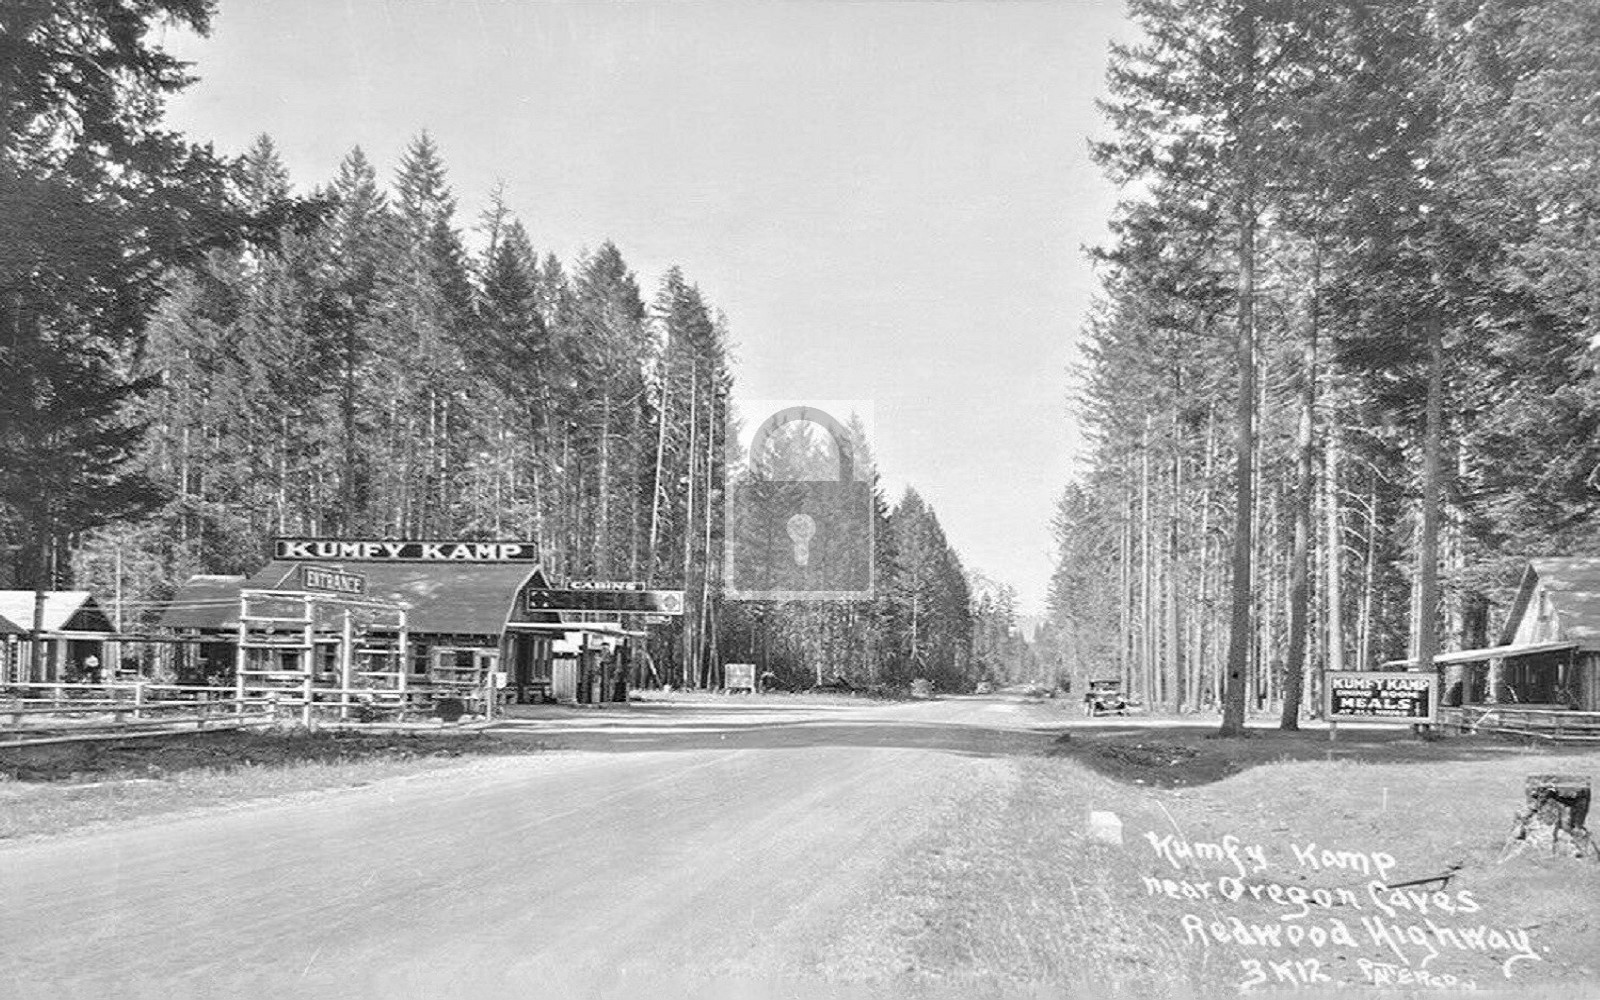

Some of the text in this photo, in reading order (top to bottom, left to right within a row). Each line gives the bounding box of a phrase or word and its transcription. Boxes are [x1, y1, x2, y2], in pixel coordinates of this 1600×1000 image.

[285, 542, 523, 560] KUMFY KAMP
[1332, 679, 1430, 691] KUMFY KAMP
[1341, 698, 1411, 710] MEALS
